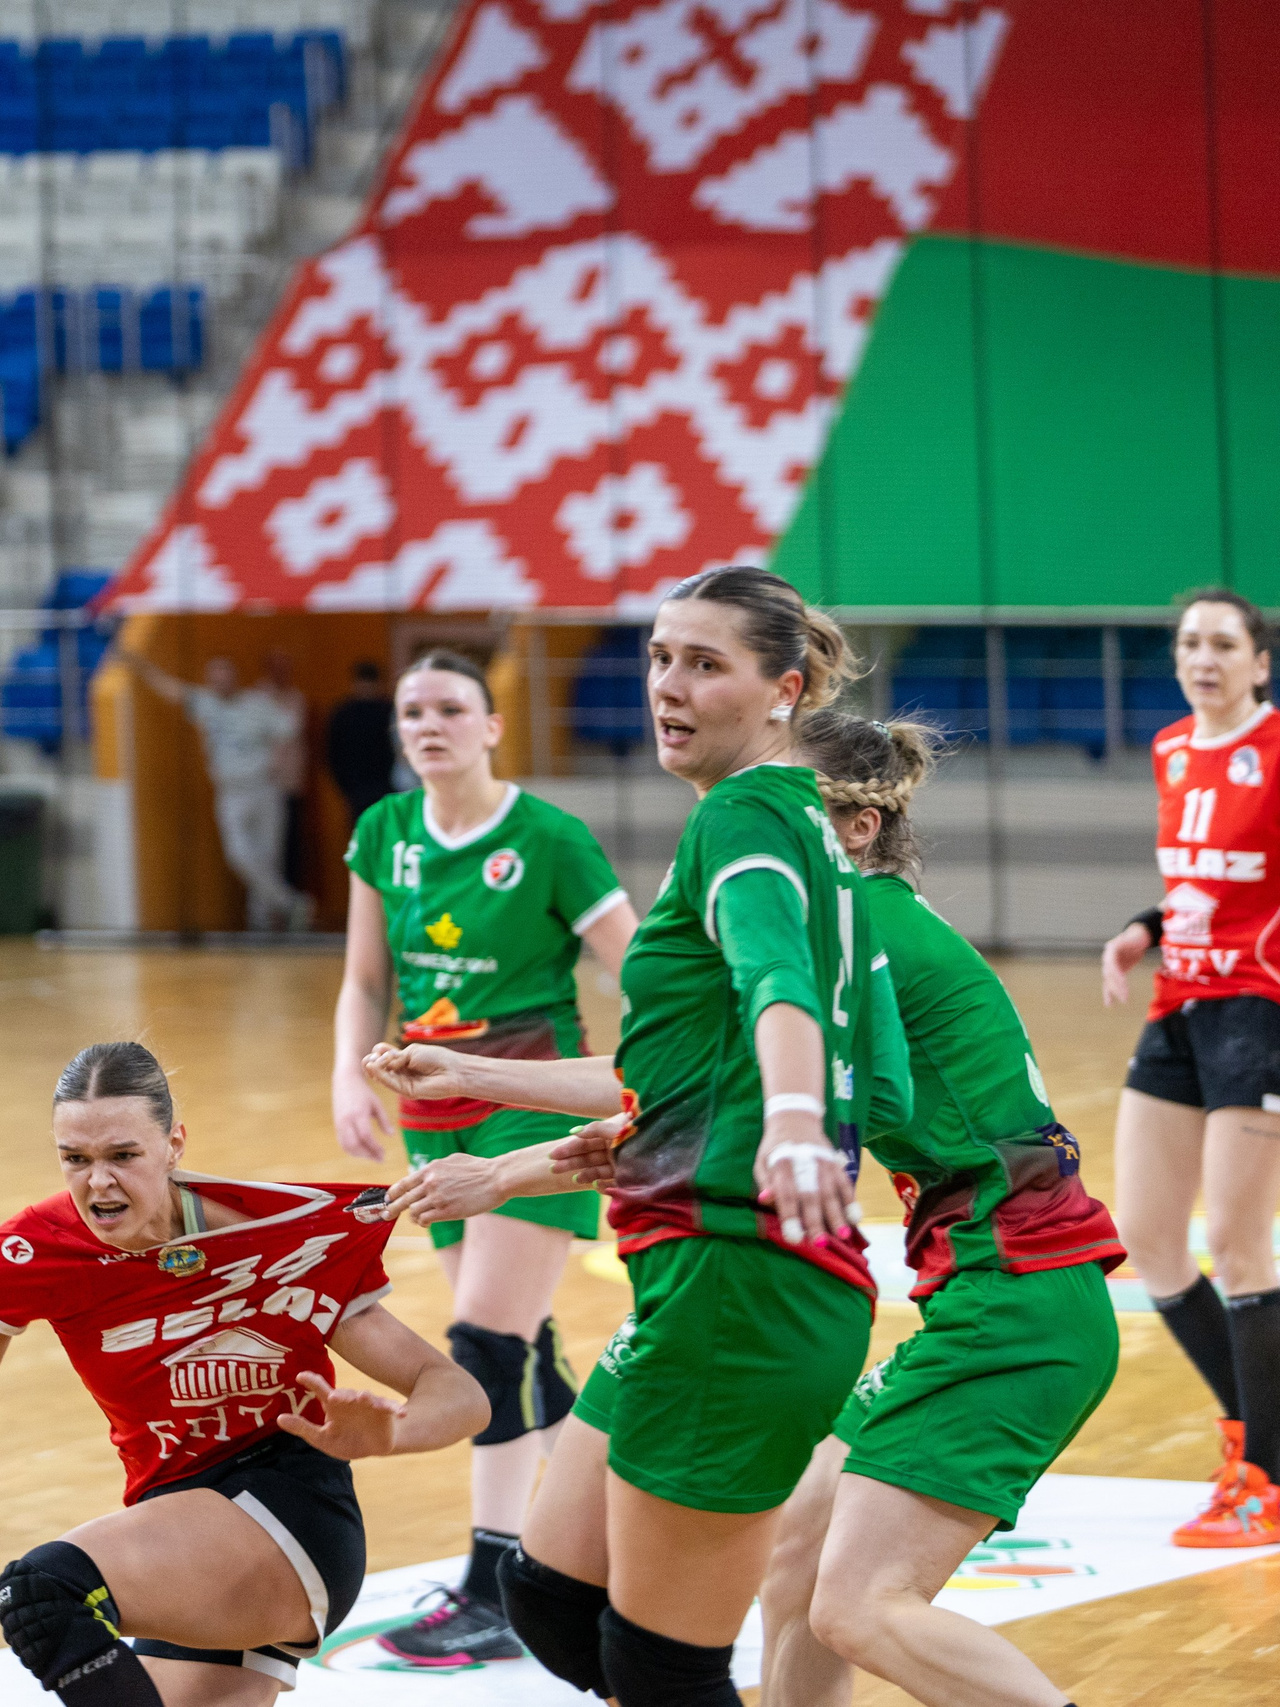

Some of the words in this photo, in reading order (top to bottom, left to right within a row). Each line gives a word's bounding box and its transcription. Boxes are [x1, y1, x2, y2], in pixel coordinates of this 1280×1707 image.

[1177, 787, 1217, 843] 11
[392, 840, 425, 888] 15
[1156, 846, 1267, 883] ELAZ
[192, 1232, 349, 1305] 34
